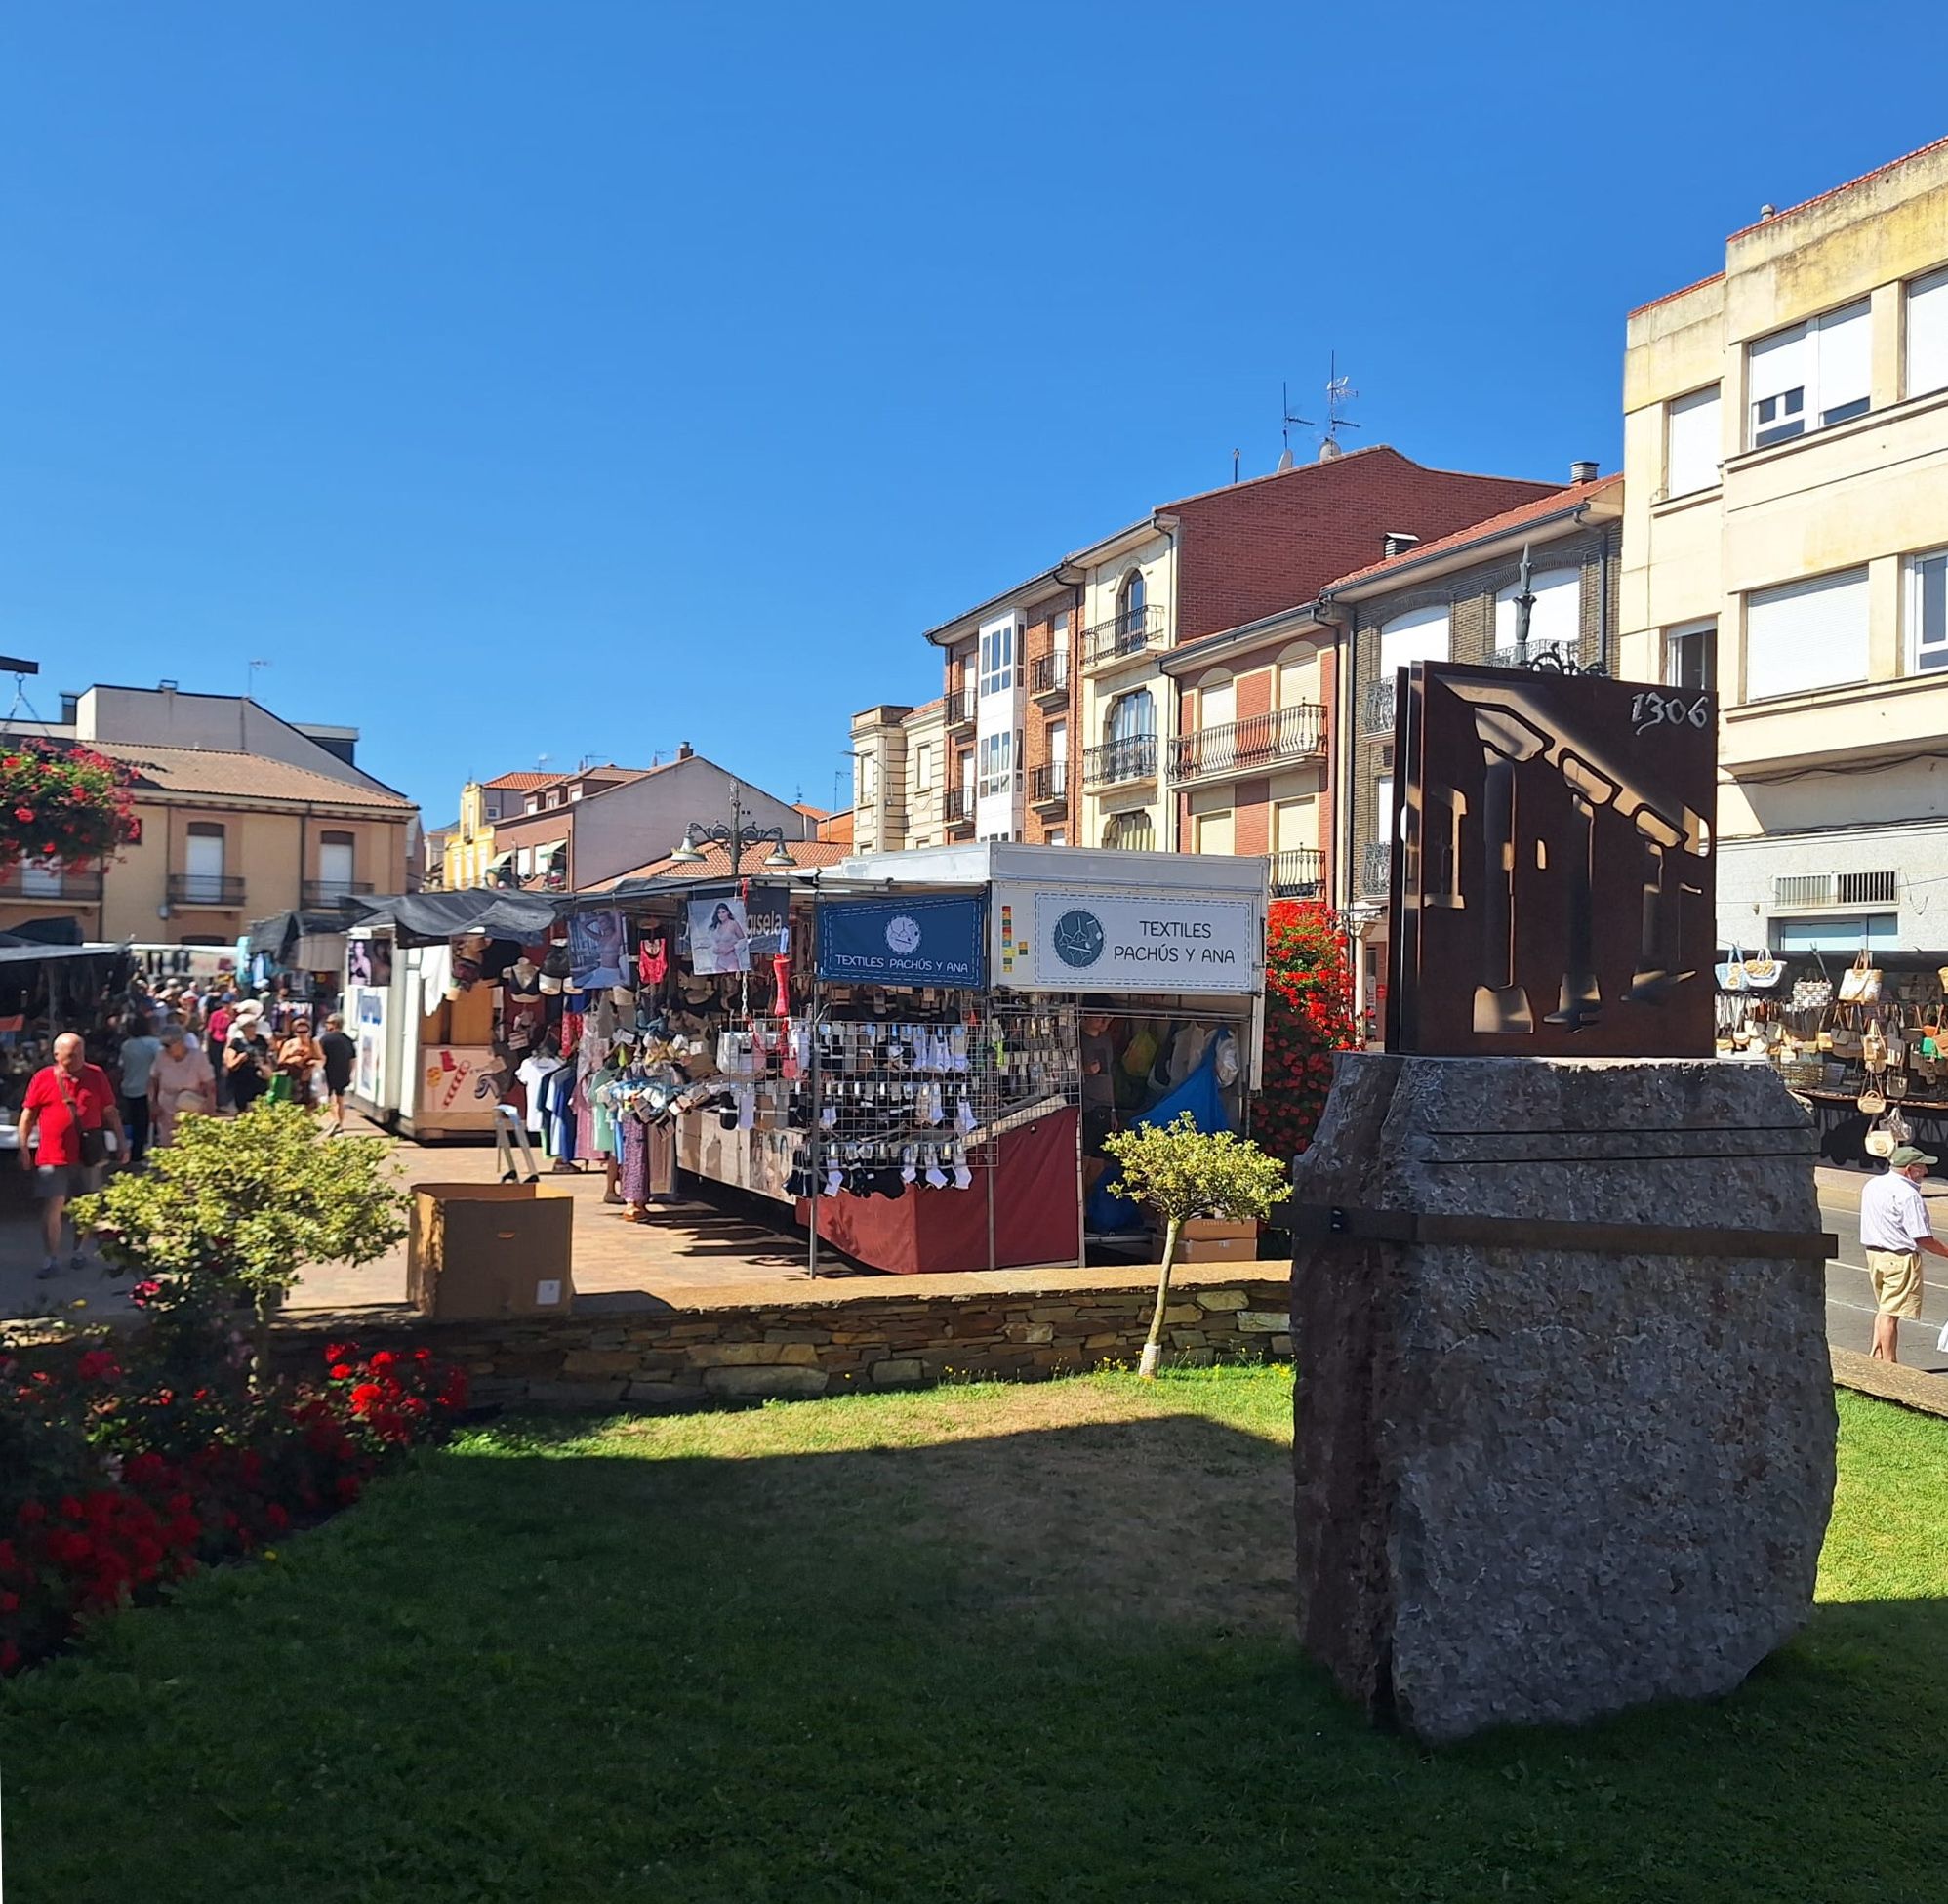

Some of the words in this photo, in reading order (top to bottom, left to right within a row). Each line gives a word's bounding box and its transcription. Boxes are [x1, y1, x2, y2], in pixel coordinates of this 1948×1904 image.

[1632, 691, 1709, 735] 1306
[1140, 921, 1212, 939] TEXTILES
[834, 954, 884, 967] TEXTILES
[889, 957, 932, 971] PACHÚS
[936, 961, 943, 971] Y
[947, 962, 968, 973] ANA
[1114, 944, 1179, 962] PACHÚS
[1186, 949, 1196, 962] Y
[1201, 949, 1235, 964] ANA
